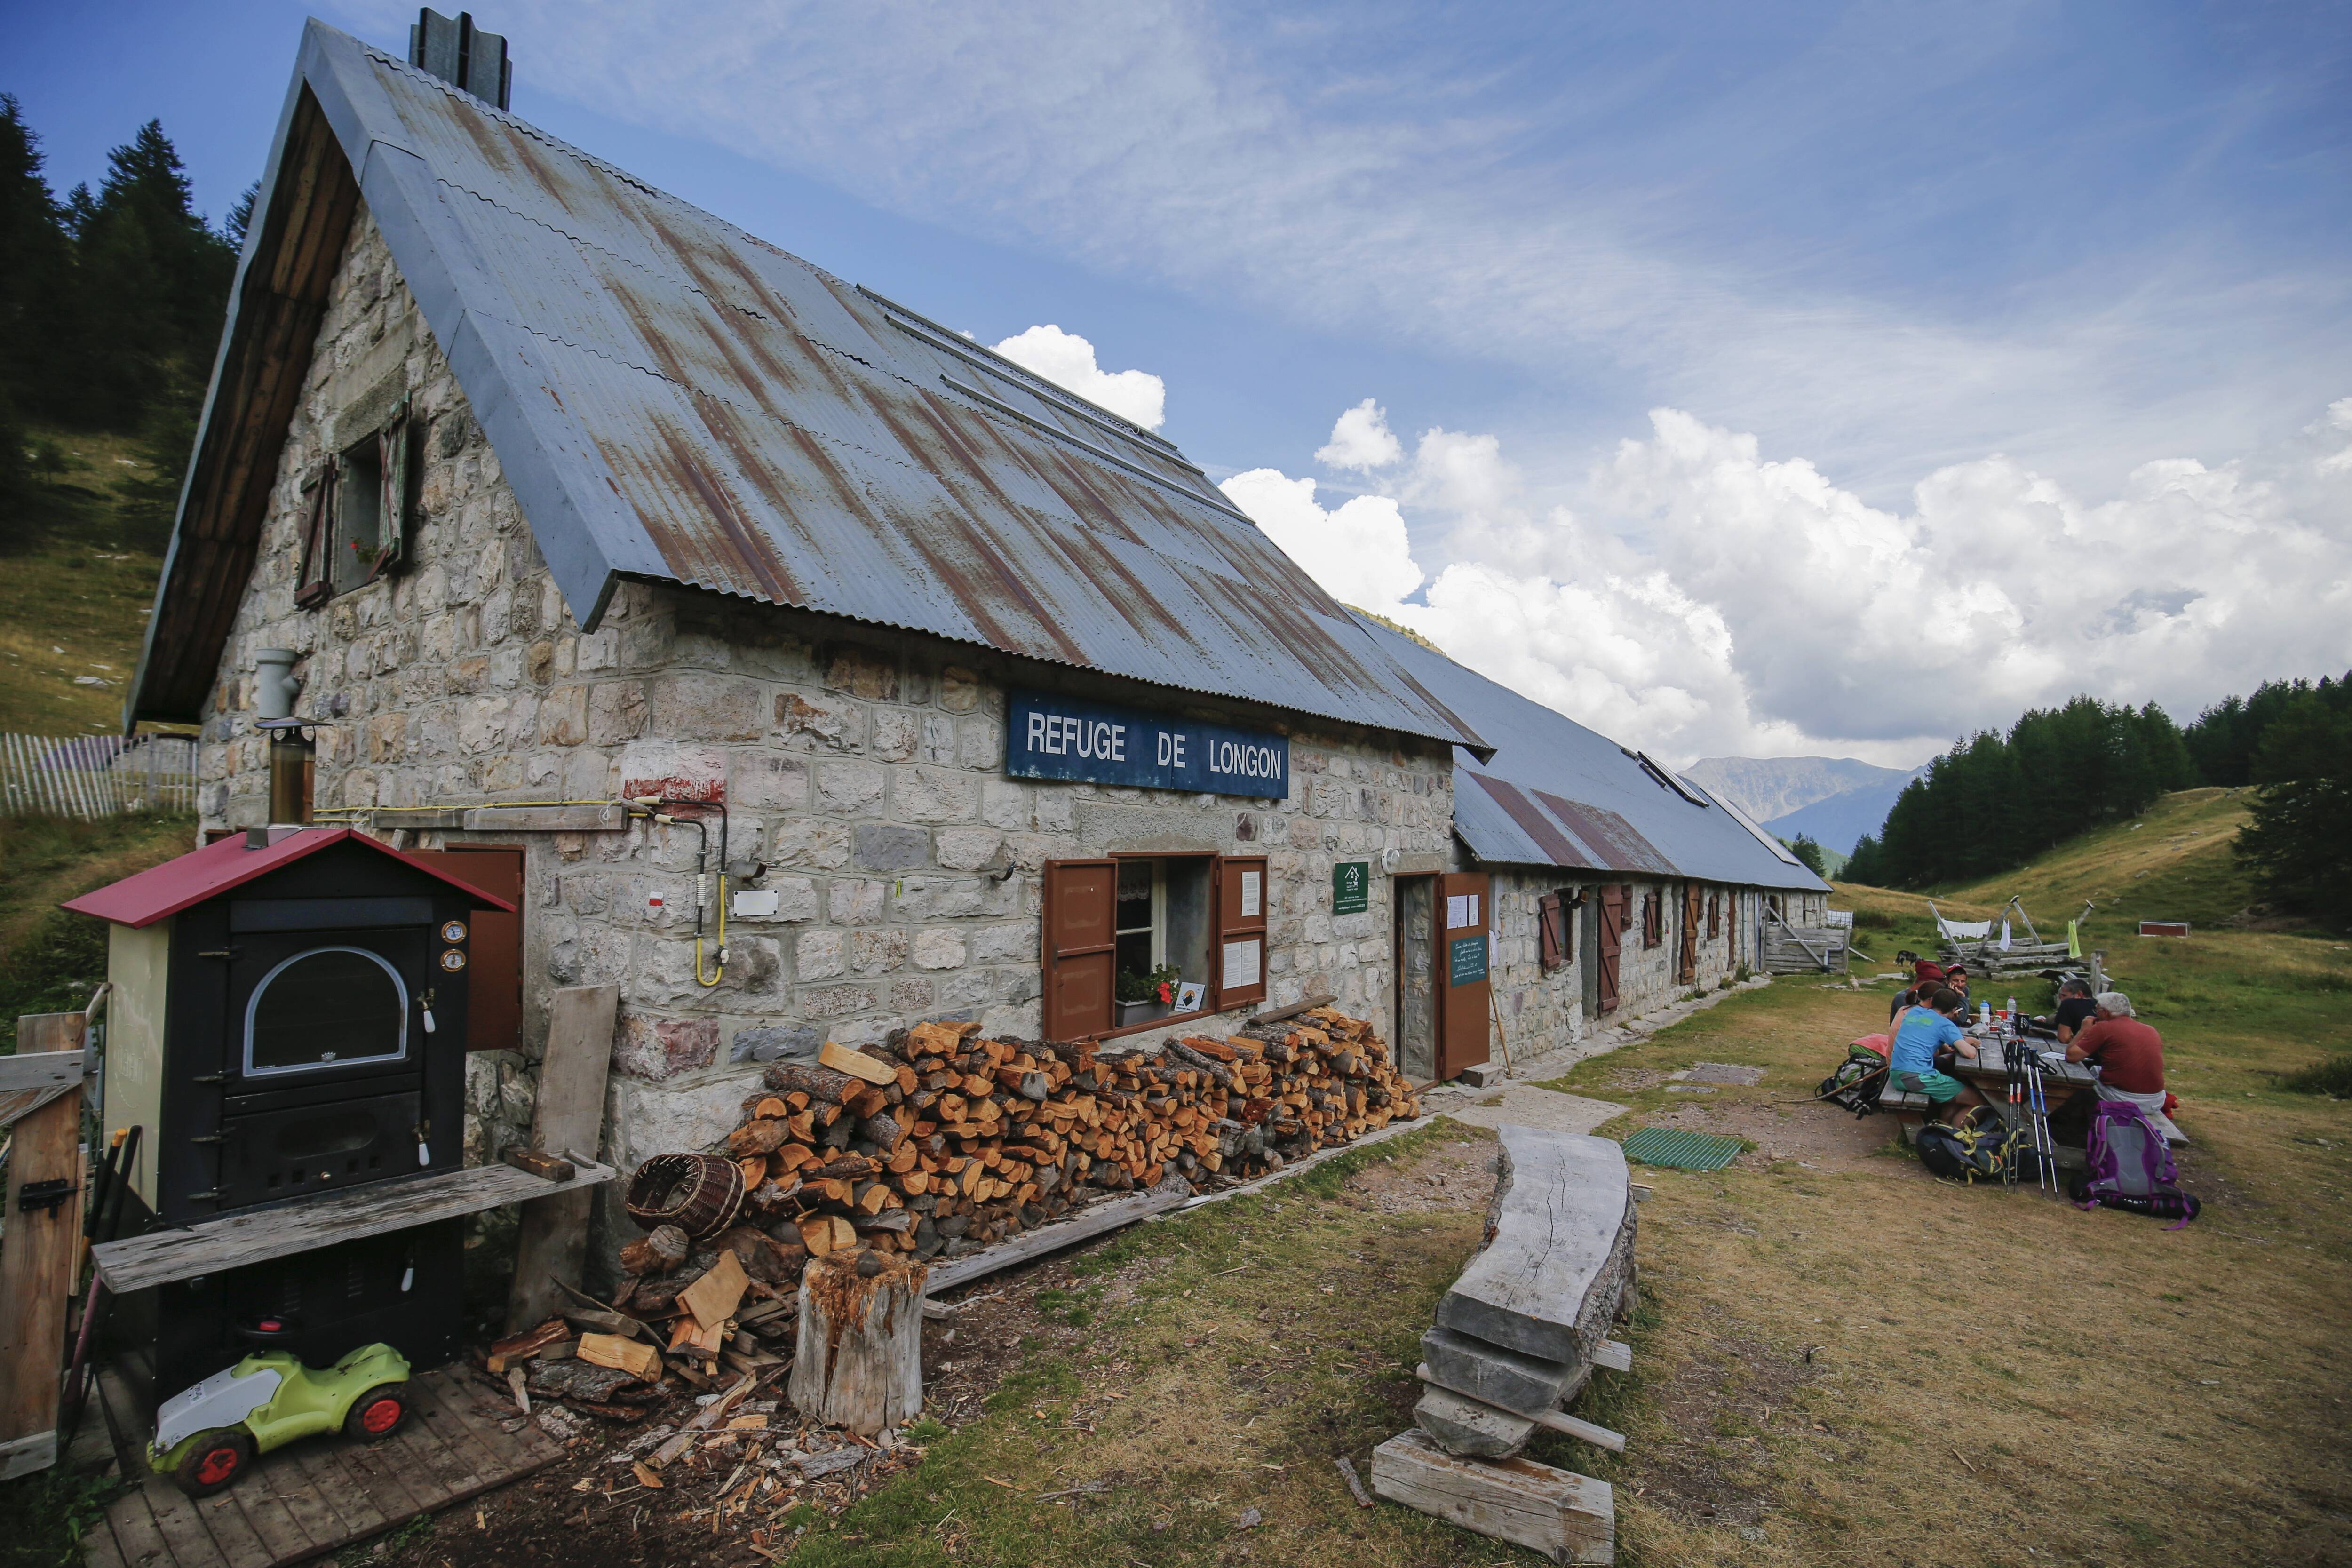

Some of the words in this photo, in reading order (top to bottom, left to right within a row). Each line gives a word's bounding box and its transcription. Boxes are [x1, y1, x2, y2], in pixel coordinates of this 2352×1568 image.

[1027, 711, 1125, 762] REFUGE
[1157, 732, 1185, 768] DE
[1210, 740, 1281, 780] LONGON
